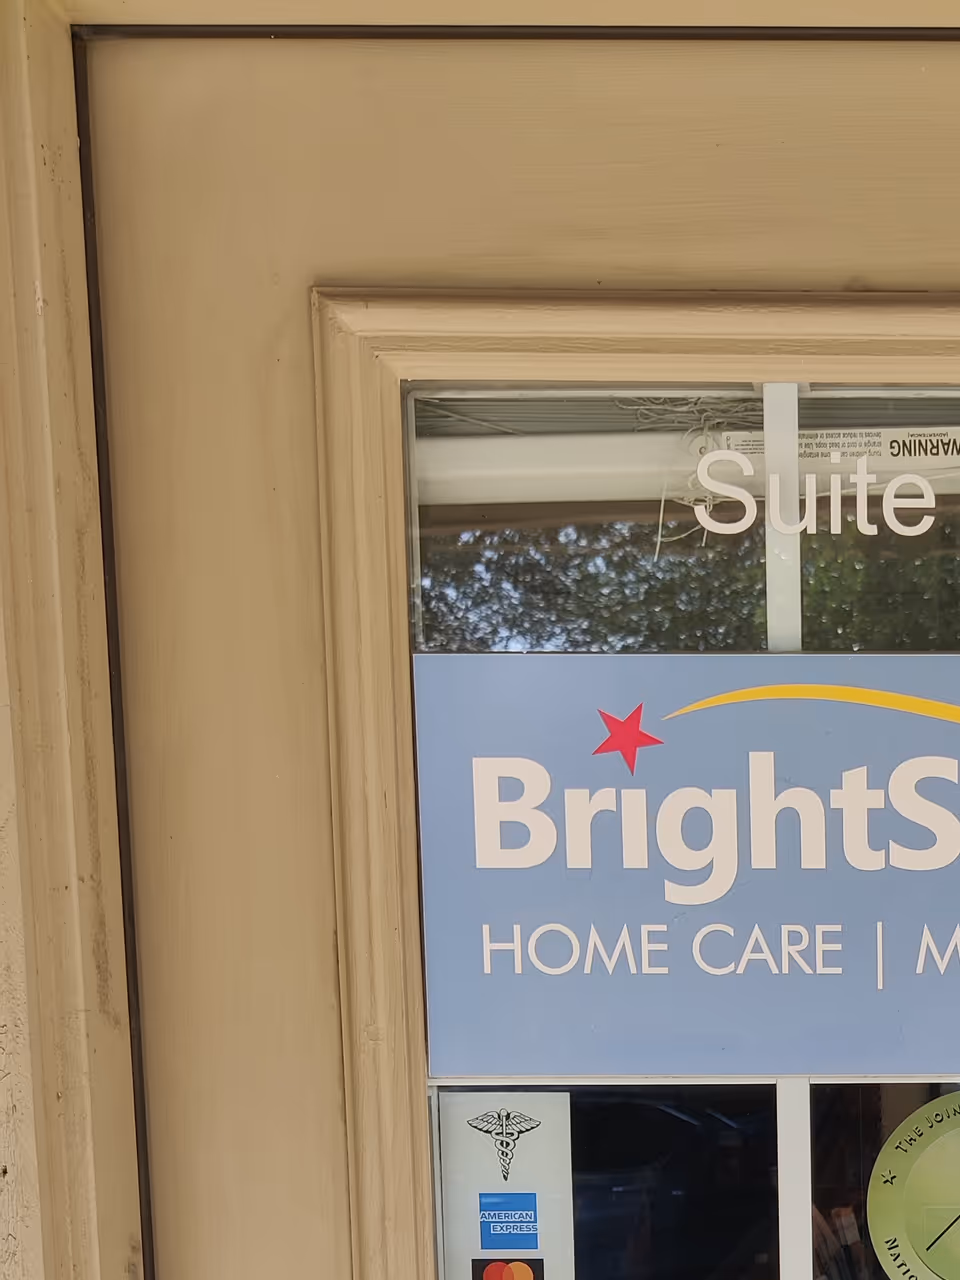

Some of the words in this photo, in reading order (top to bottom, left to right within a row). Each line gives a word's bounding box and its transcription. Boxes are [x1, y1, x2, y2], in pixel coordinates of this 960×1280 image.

[694, 449, 937, 537] Suite
[481, 922, 669, 977] HOME
[692, 922, 844, 977] CARE
[894, 1126, 924, 1155] THE
[480, 1211, 533, 1221] AMERICAN
[491, 1224, 538, 1233] EXPRESS
